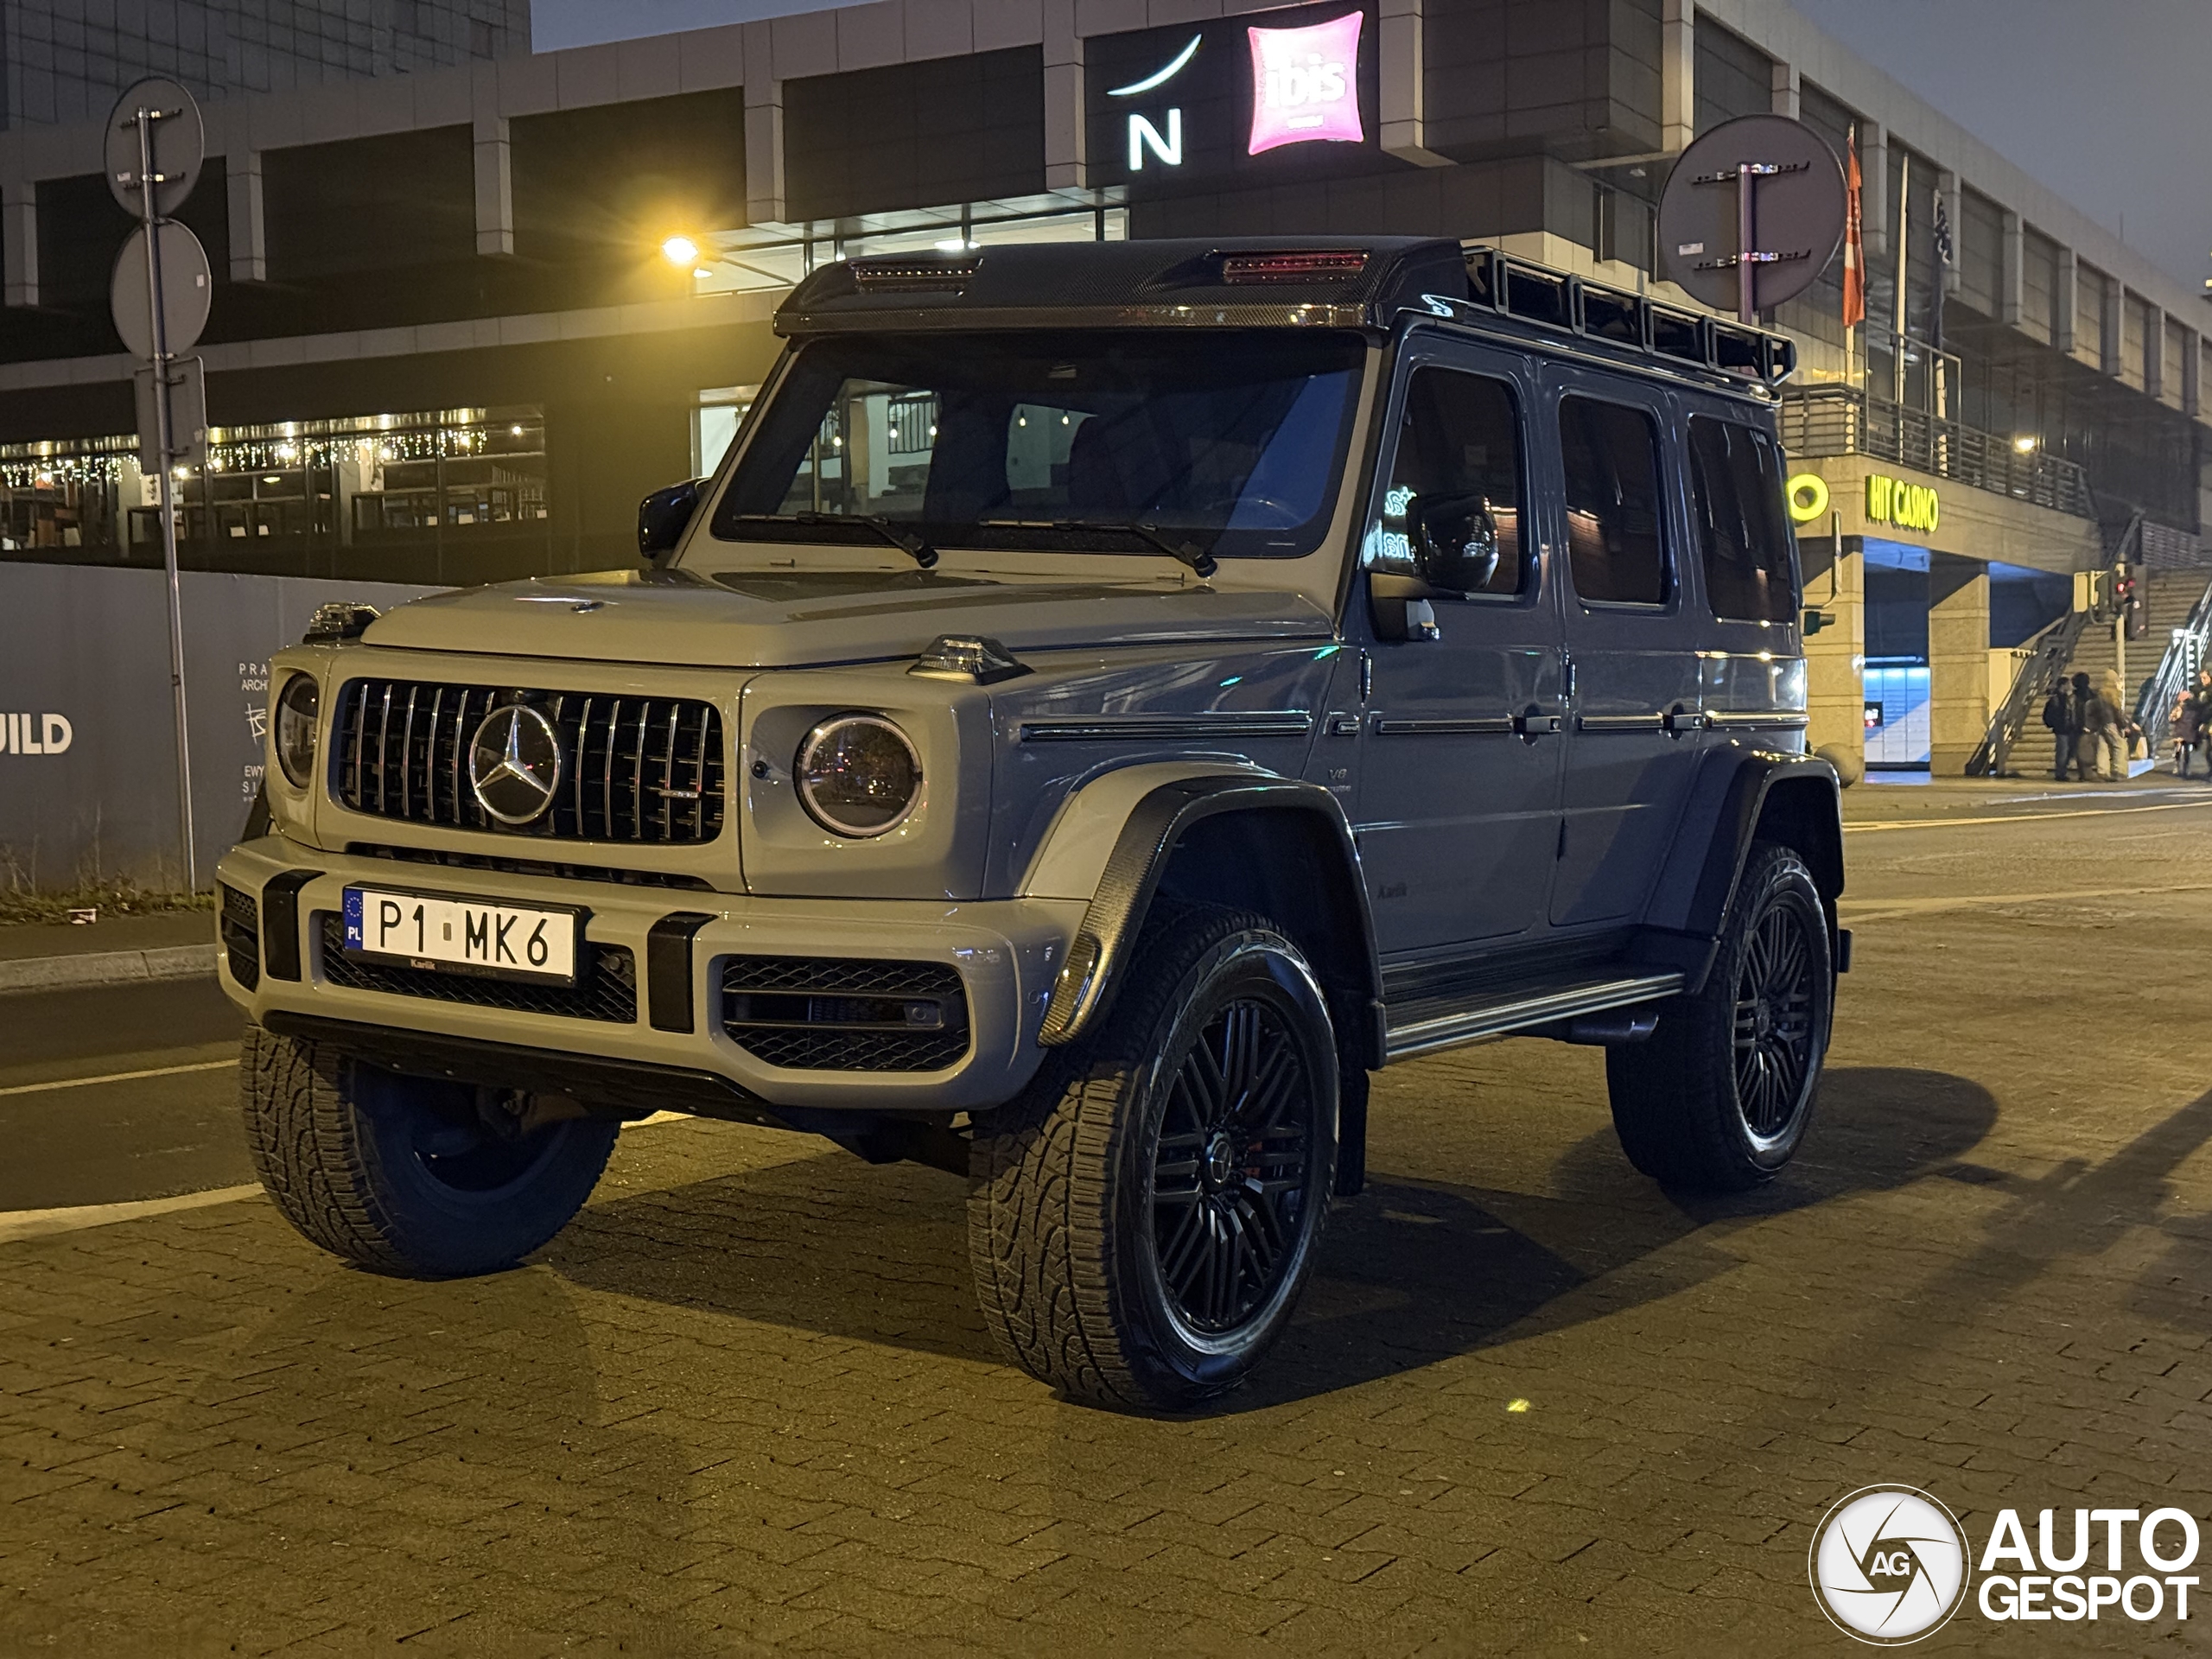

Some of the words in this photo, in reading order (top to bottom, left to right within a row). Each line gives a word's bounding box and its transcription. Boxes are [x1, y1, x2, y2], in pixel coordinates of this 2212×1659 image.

[1263, 52, 1347, 108] ibis
[1129, 108, 1182, 171] N
[1869, 474, 1892, 521] HIT
[1892, 480, 1940, 532] CASINO
[238, 663, 268, 676] PRA
[347, 925, 361, 942] PL
[379, 899, 424, 953] P1
[466, 910, 549, 967] MK6
